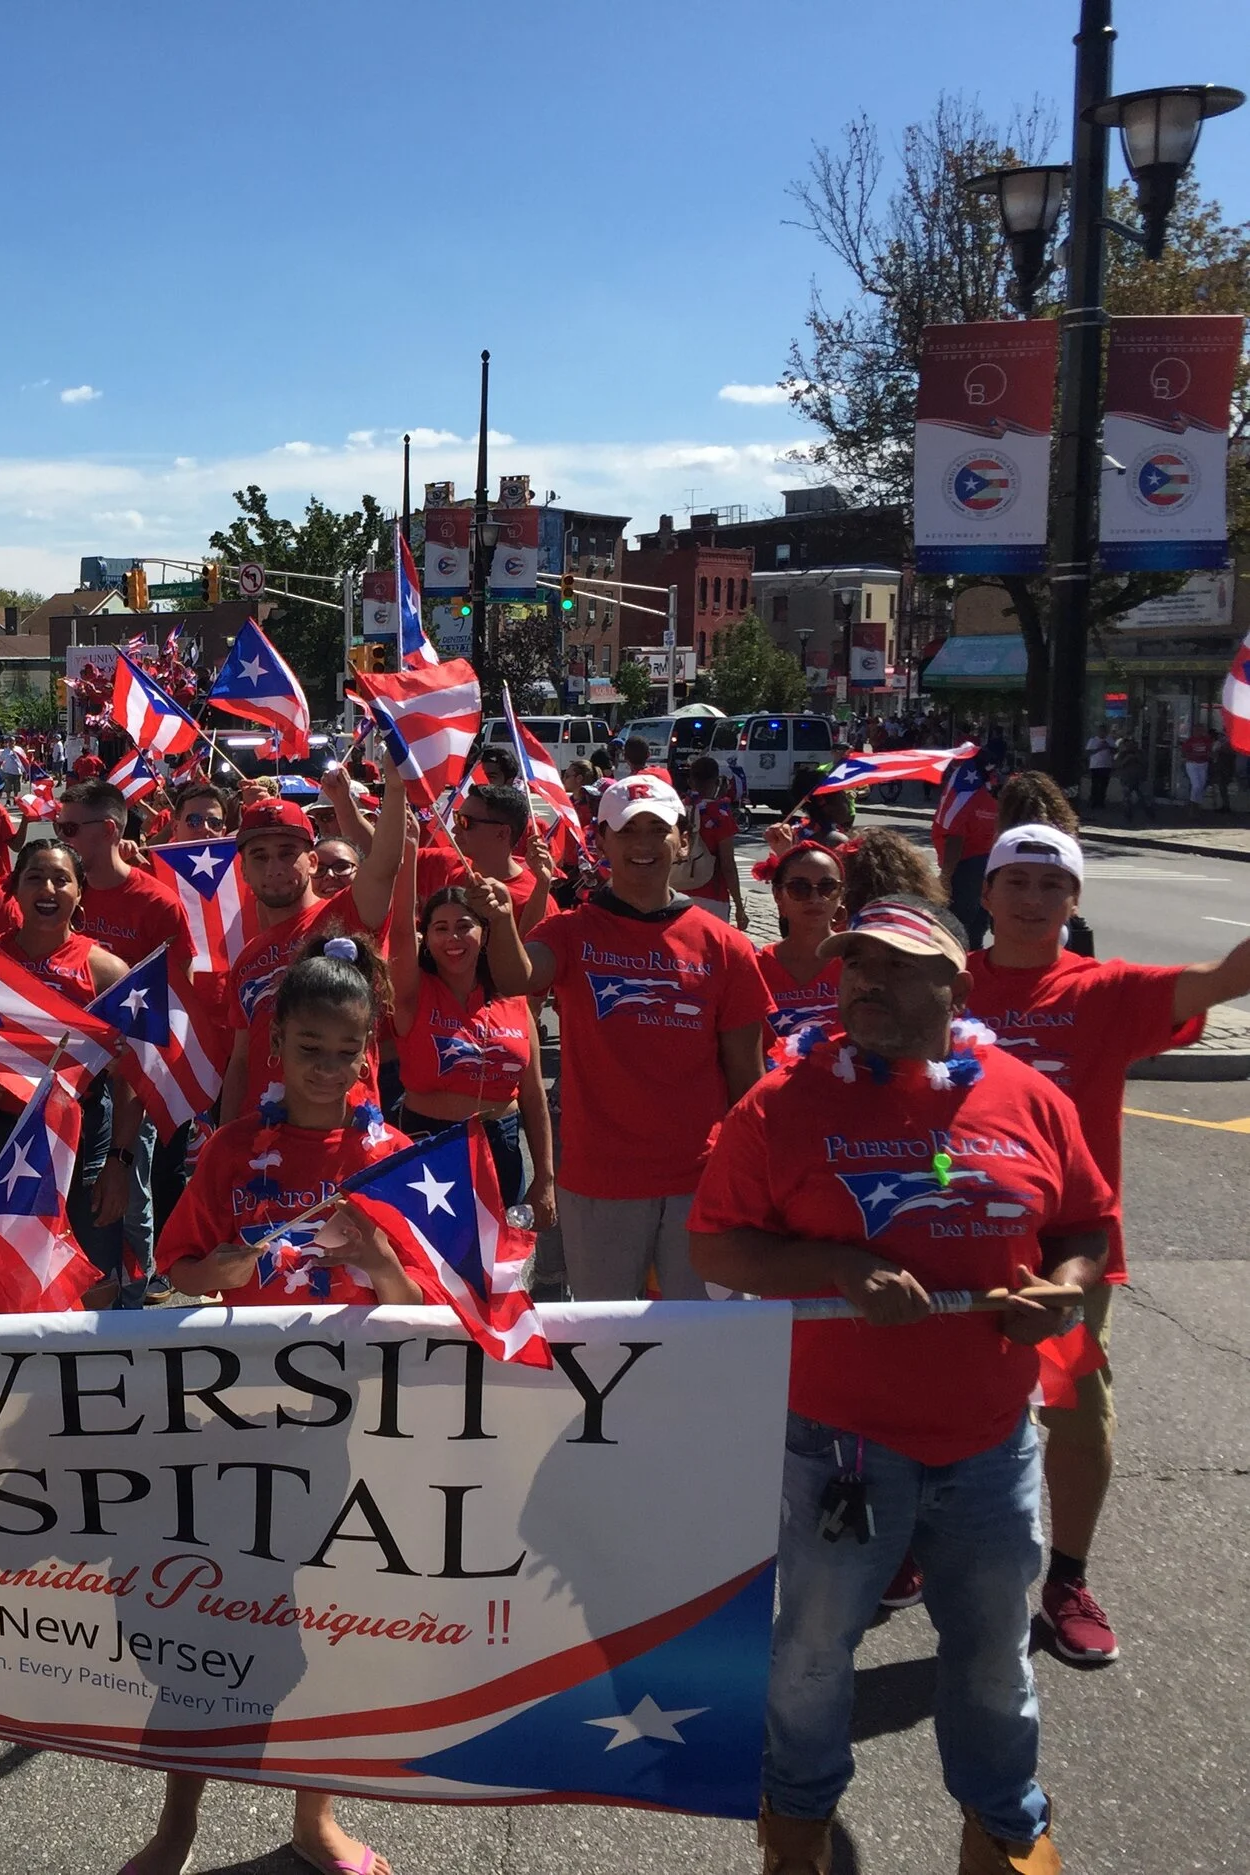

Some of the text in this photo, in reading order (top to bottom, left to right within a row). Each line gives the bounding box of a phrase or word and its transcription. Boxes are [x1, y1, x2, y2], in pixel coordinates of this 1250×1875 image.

[629, 783, 651, 800] R
[581, 941, 711, 976] PUERTO RICAN
[638, 1013, 703, 1030] DAY PARADE
[1004, 1009, 1075, 1029] RICAN
[824, 1129, 1027, 1162] PUERTO RICAN
[930, 1220, 1027, 1239] DAY PARADE
[145, 1553, 473, 1648] Puertoriqueña
[109, 1619, 254, 1690] Jersey
[19, 1656, 72, 1685] Every
[78, 1665, 153, 1698] Patient.
[160, 1686, 216, 1715] Every
[224, 1697, 275, 1717] Time
